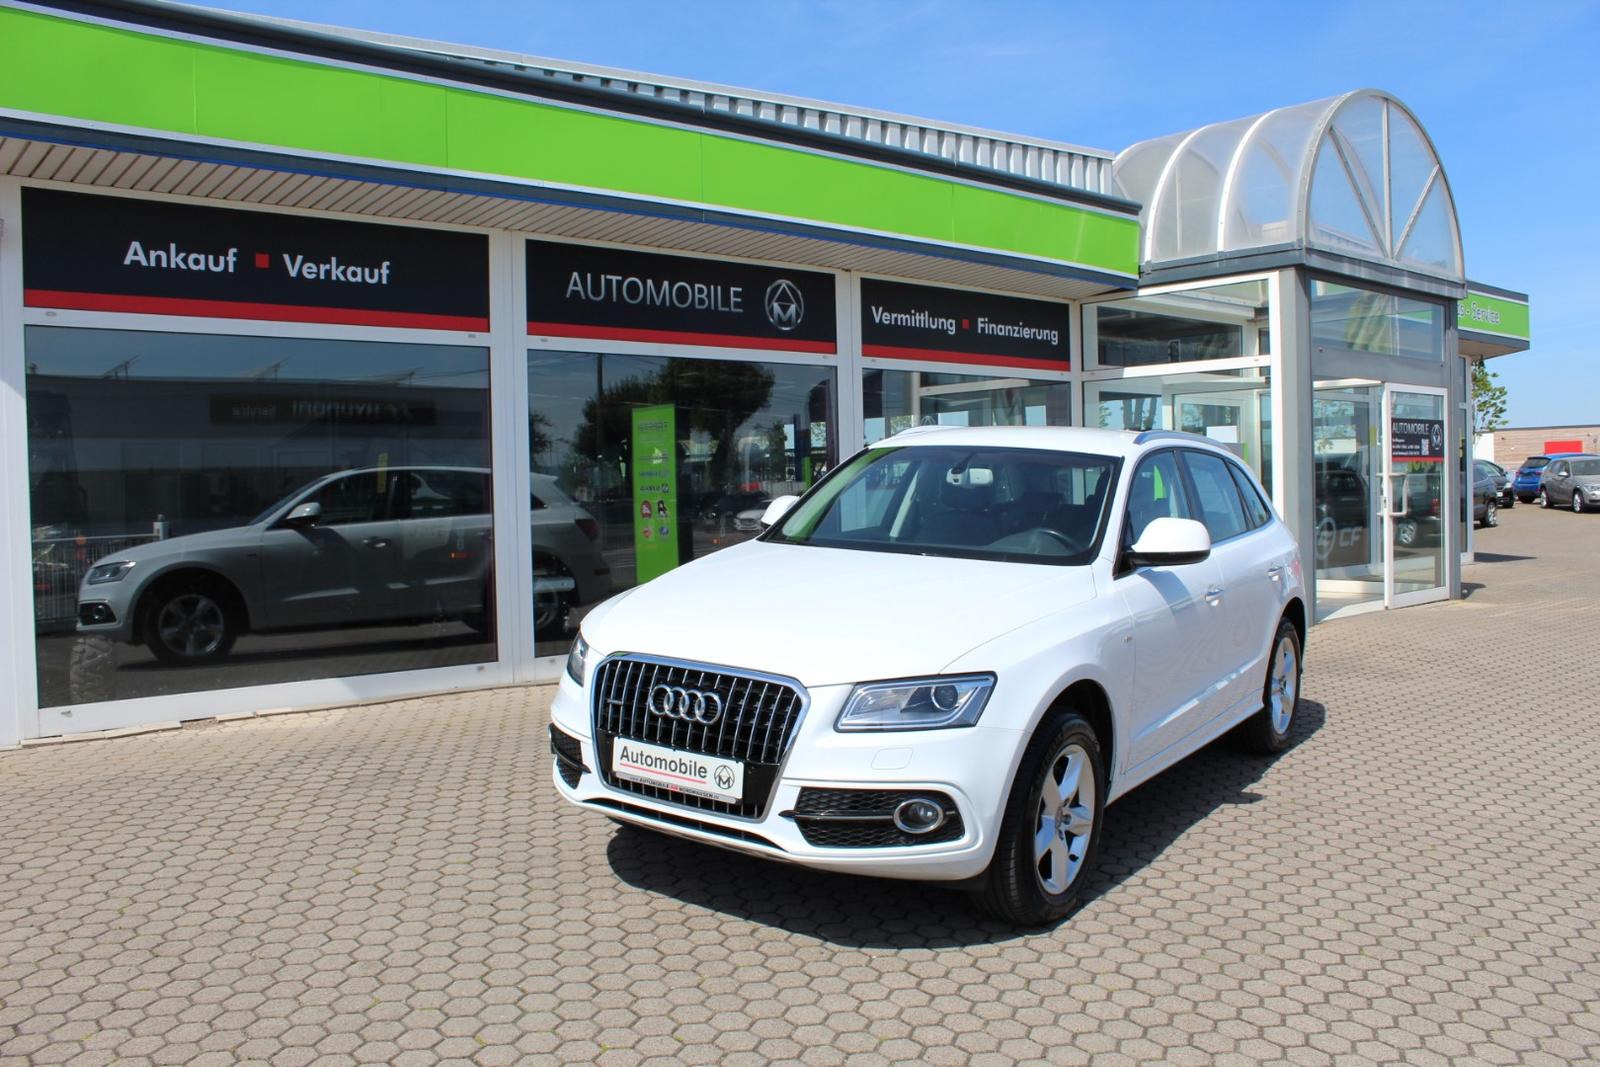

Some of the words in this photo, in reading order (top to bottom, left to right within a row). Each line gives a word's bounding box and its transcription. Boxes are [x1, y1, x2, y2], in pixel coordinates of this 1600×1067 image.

[123, 240, 238, 273] Ankauf
[282, 253, 391, 285] Verkauf
[565, 271, 744, 313] AUTOMOBILE
[871, 305, 956, 335] Vermittlung
[977, 317, 1059, 345] Finanzierung
[1392, 422, 1430, 435] AUTOMOBILE
[620, 745, 708, 779] Automobile
